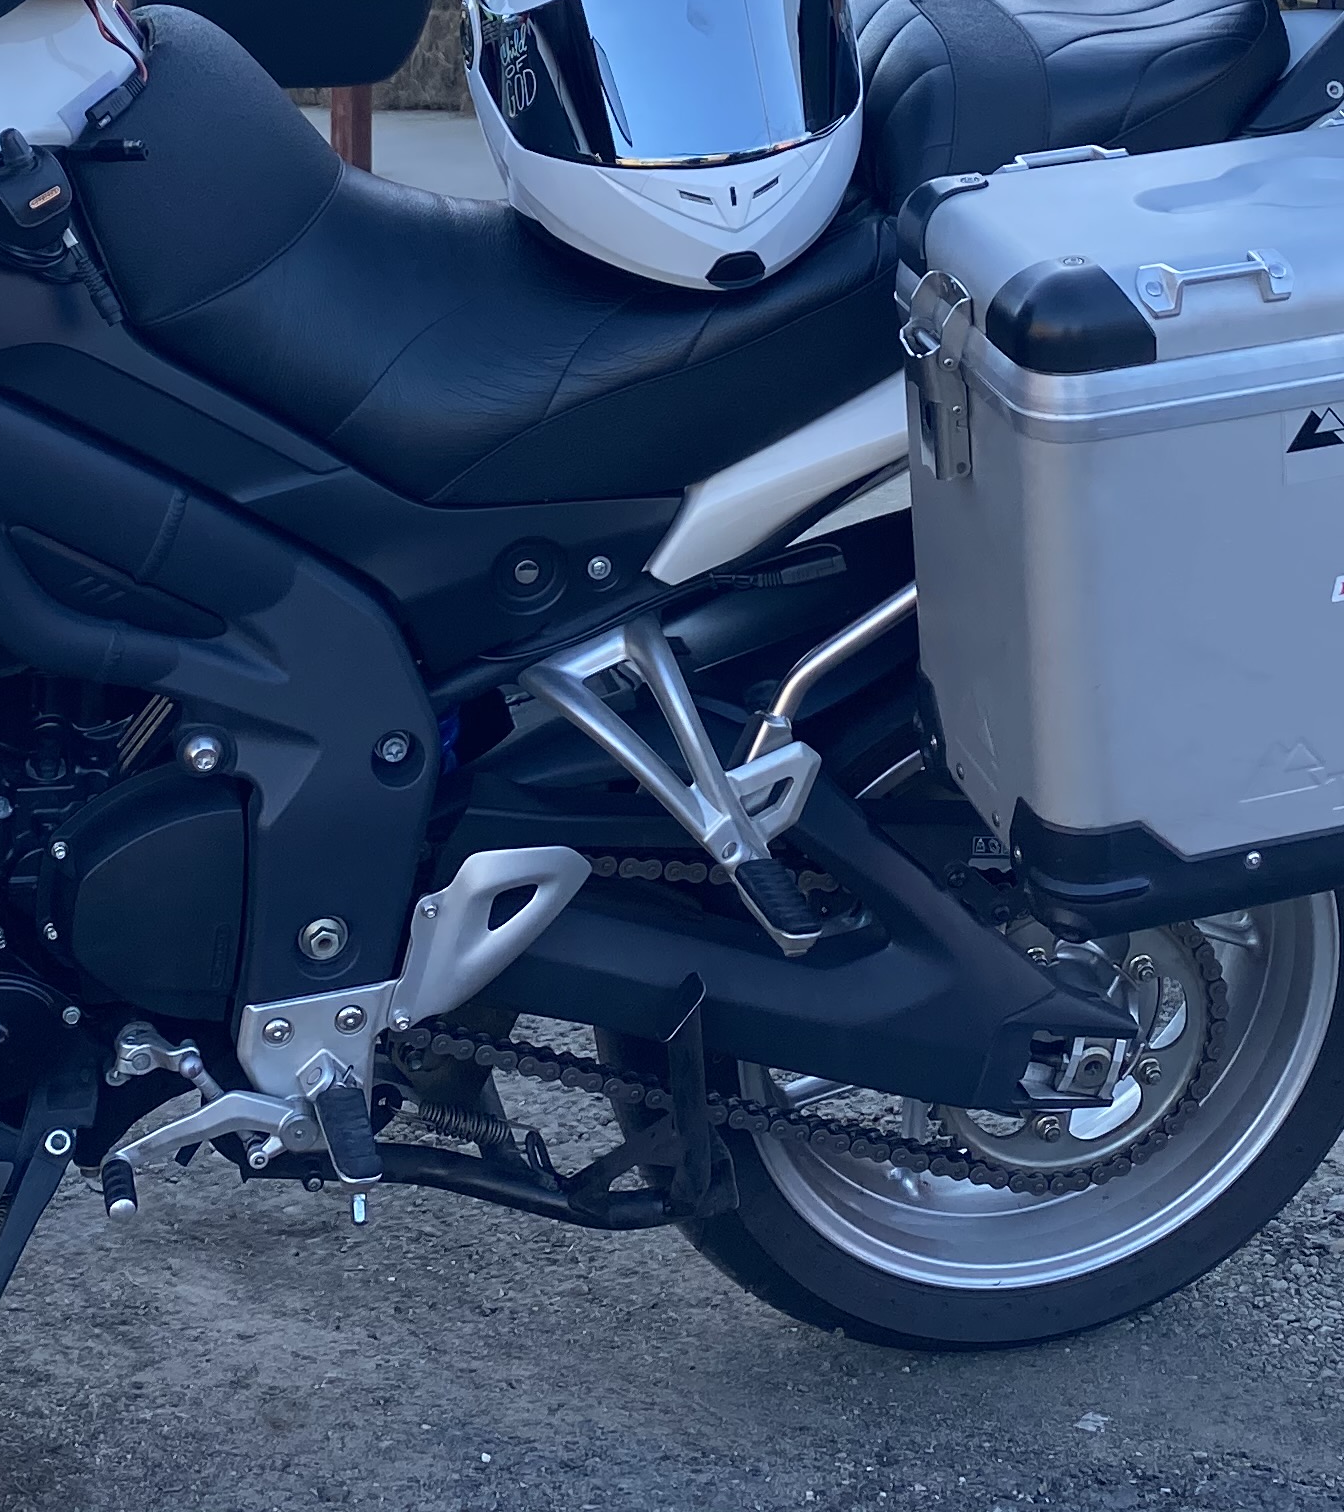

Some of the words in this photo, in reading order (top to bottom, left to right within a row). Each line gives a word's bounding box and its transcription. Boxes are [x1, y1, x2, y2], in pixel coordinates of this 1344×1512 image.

[500, 23, 528, 67] Child
[504, 54, 528, 79] OF
[505, 68, 537, 118] GOD
